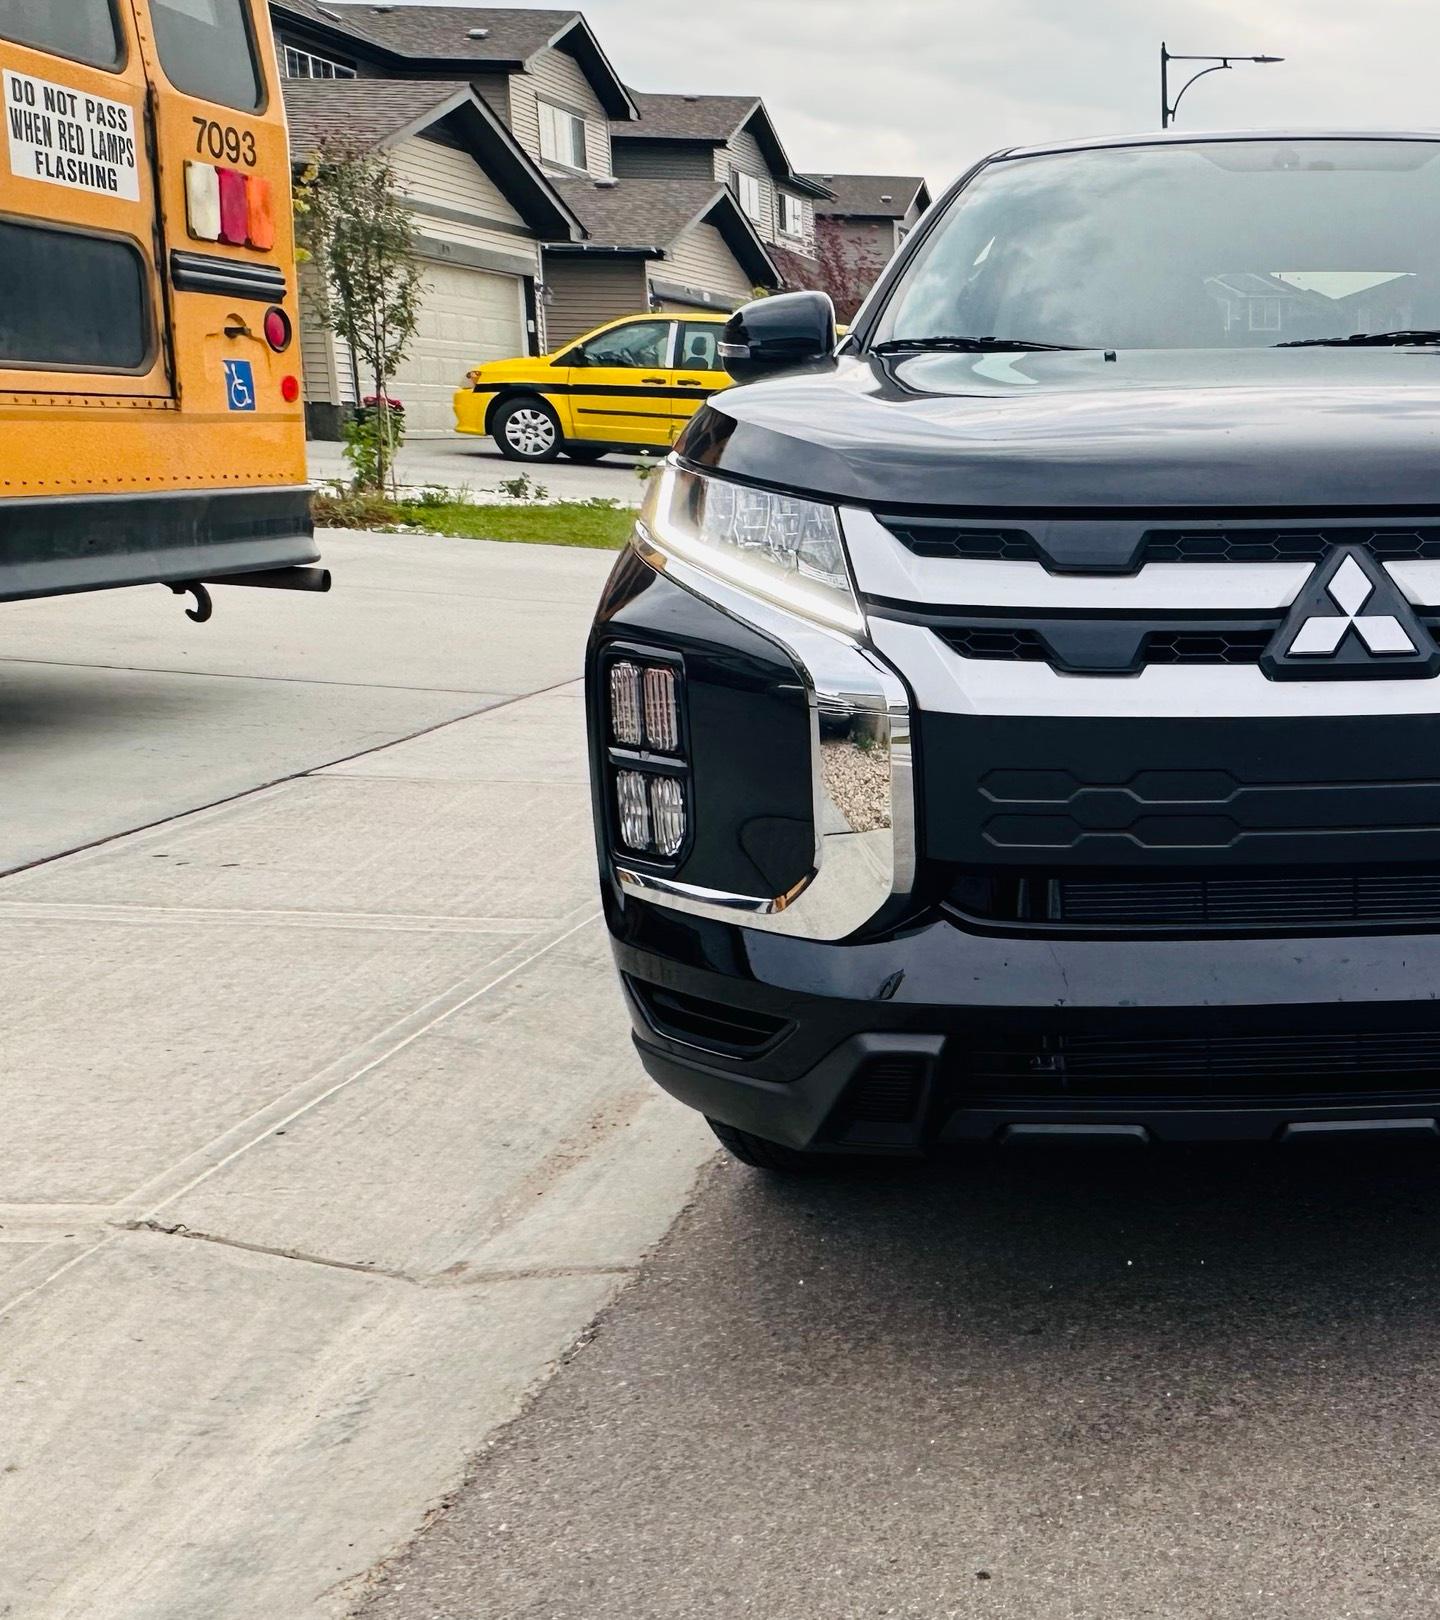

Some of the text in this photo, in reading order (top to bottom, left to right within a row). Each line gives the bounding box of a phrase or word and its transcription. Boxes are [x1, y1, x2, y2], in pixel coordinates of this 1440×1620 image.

[11, 77, 127, 132] DO NOT PASS
[9, 107, 134, 168] WHEN RED LAMPS
[192, 116, 257, 167] 7093
[35, 150, 118, 192] FLASHING
